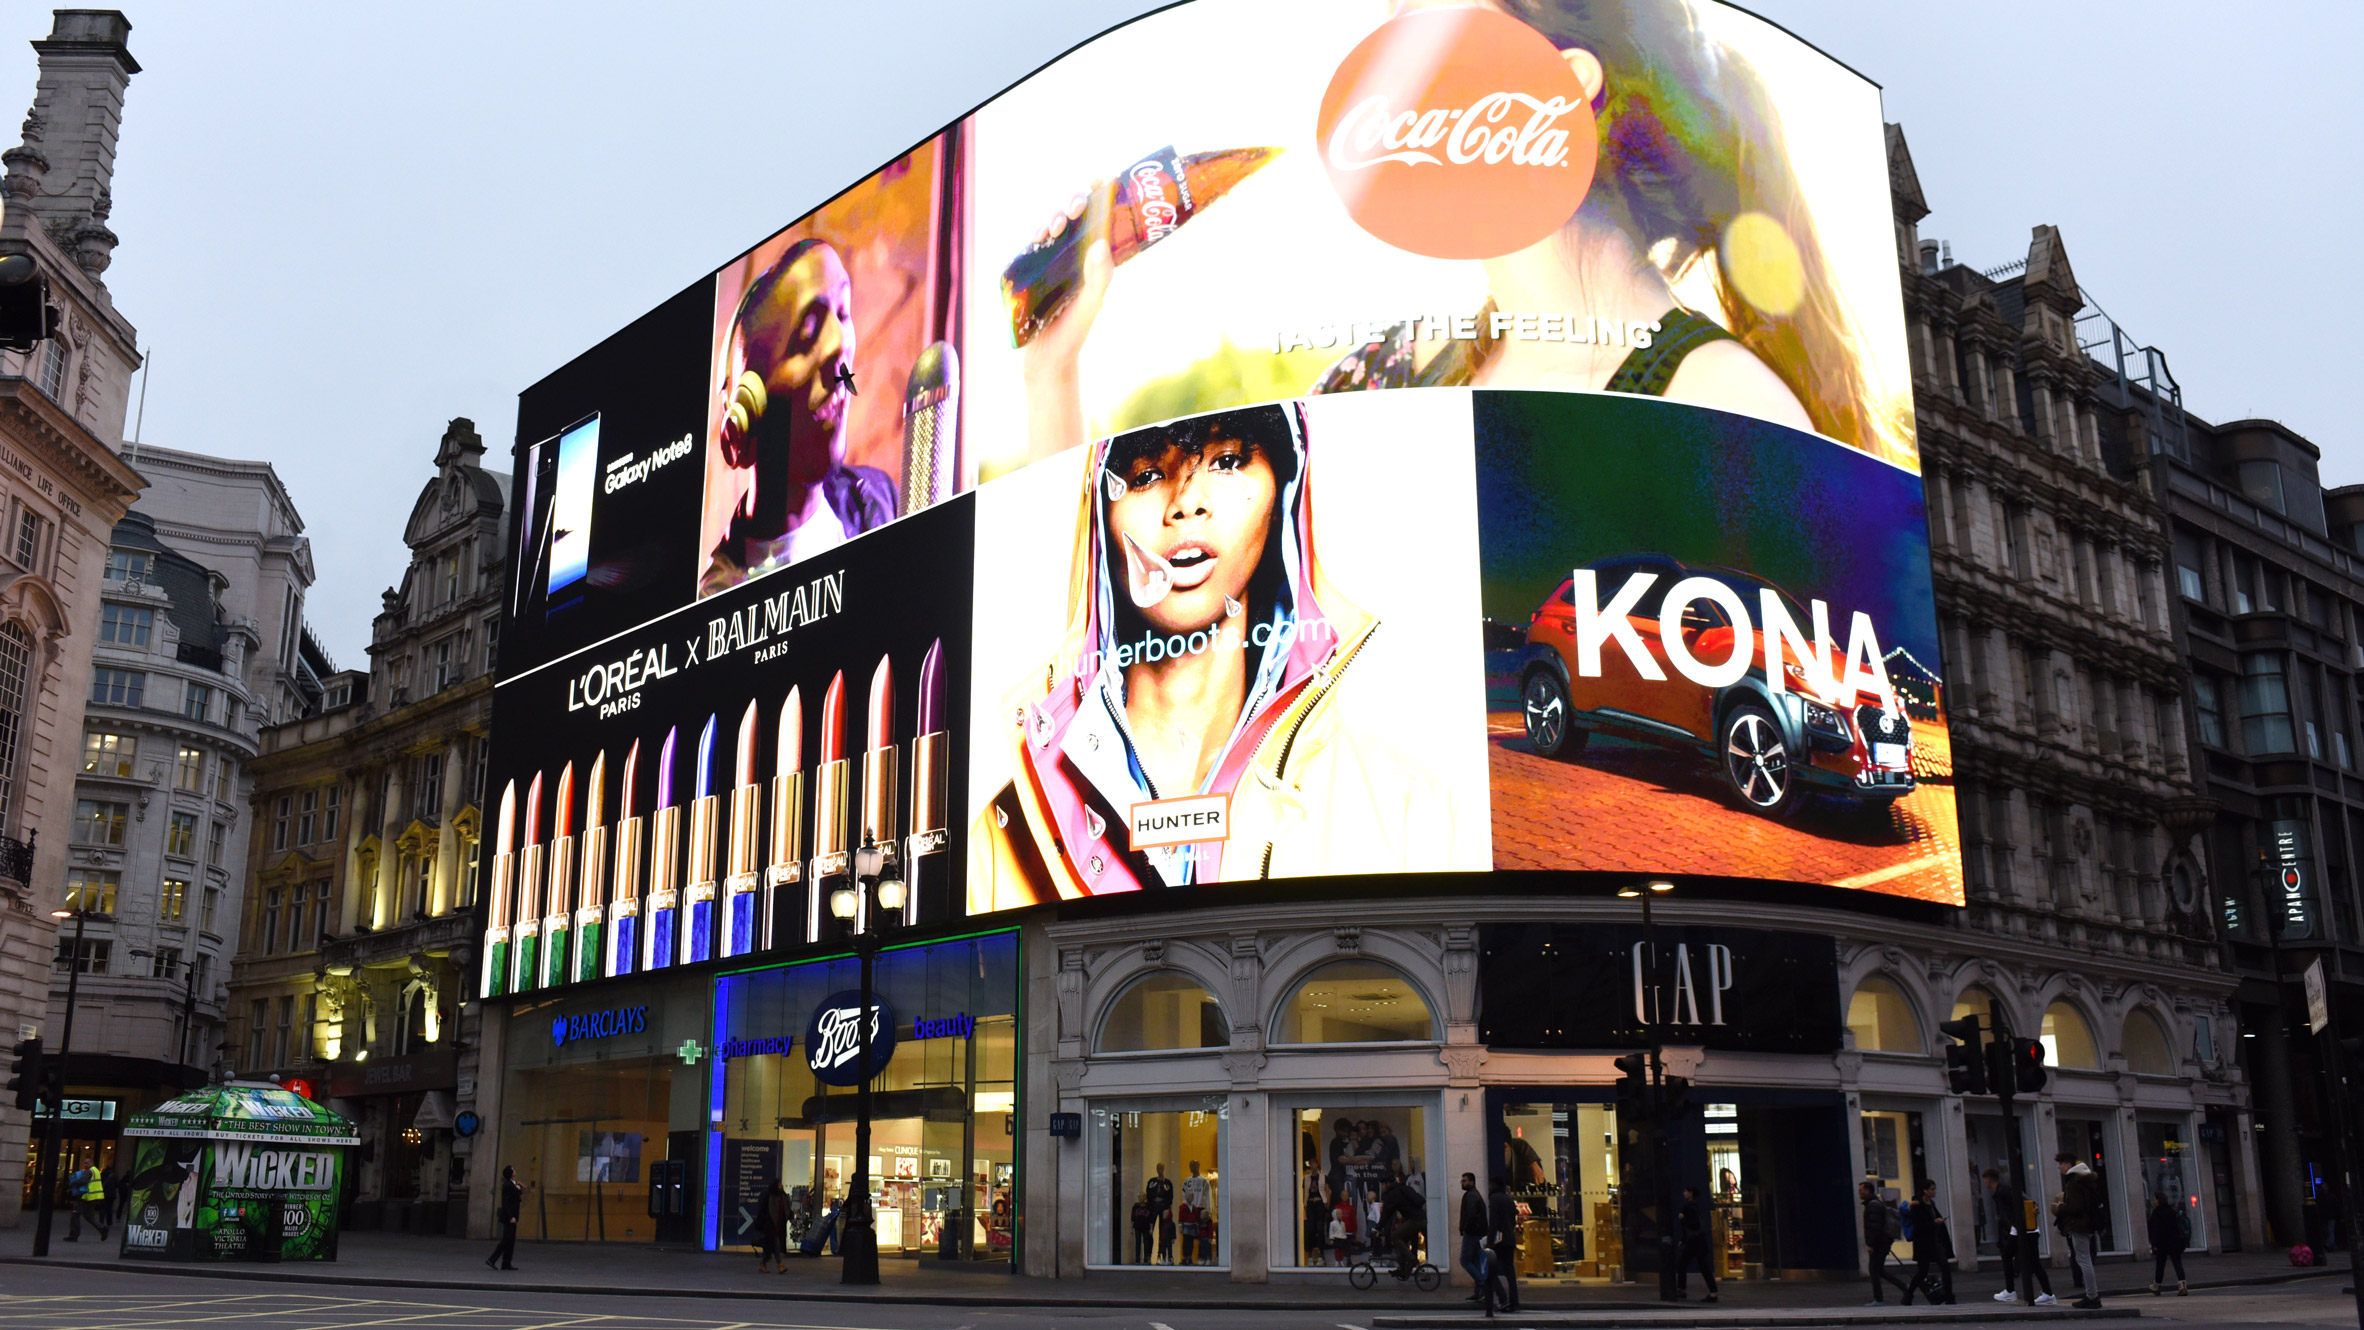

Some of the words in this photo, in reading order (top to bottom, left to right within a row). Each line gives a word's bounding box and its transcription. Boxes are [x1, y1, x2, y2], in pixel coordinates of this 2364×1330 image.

[1130, 160, 1178, 242] Coca-Cola
[1179, 182, 1193, 211] SUGAR
[1271, 318, 1387, 354] TASTE
[1400, 313, 1479, 342] THE
[604, 457, 652, 495] Galaxy
[652, 432, 693, 472] Note8
[0, 445, 33, 481] LLIANCE
[37, 474, 54, 497] LIFE
[58, 491, 82, 518] OFFICE
[568, 643, 678, 712] L'ORÉAL
[706, 569, 846, 662] BALMAIN
[754, 641, 789, 665] PARIS
[1058, 616, 1331, 680] hunerboots.com
[1573, 568, 1900, 721] KONA
[1138, 811, 1220, 832] HUNTER
[2278, 831, 2301, 892] CENTRE
[1633, 941, 1733, 1026] GAP
[569, 1005, 647, 1041] BARCLAYS
[914, 1011, 975, 1041] beauty
[722, 1035, 793, 1062] pharmacy
[365, 1065, 390, 1085] JEWEL
[392, 1063, 413, 1083] BAR
[248, 1121, 271, 1131] BEST
[273, 1122, 300, 1132] SHOW
[301, 1124, 313, 1133] IN
[213, 1141, 335, 1191] WICKED
[894, 1145, 919, 1156] CLINIQUE
[225, 1191, 250, 1199] UNTOLD
[250, 1191, 269, 1200] STORY
[283, 1210, 305, 1226] 100
[128, 1224, 168, 1247] WICKED
